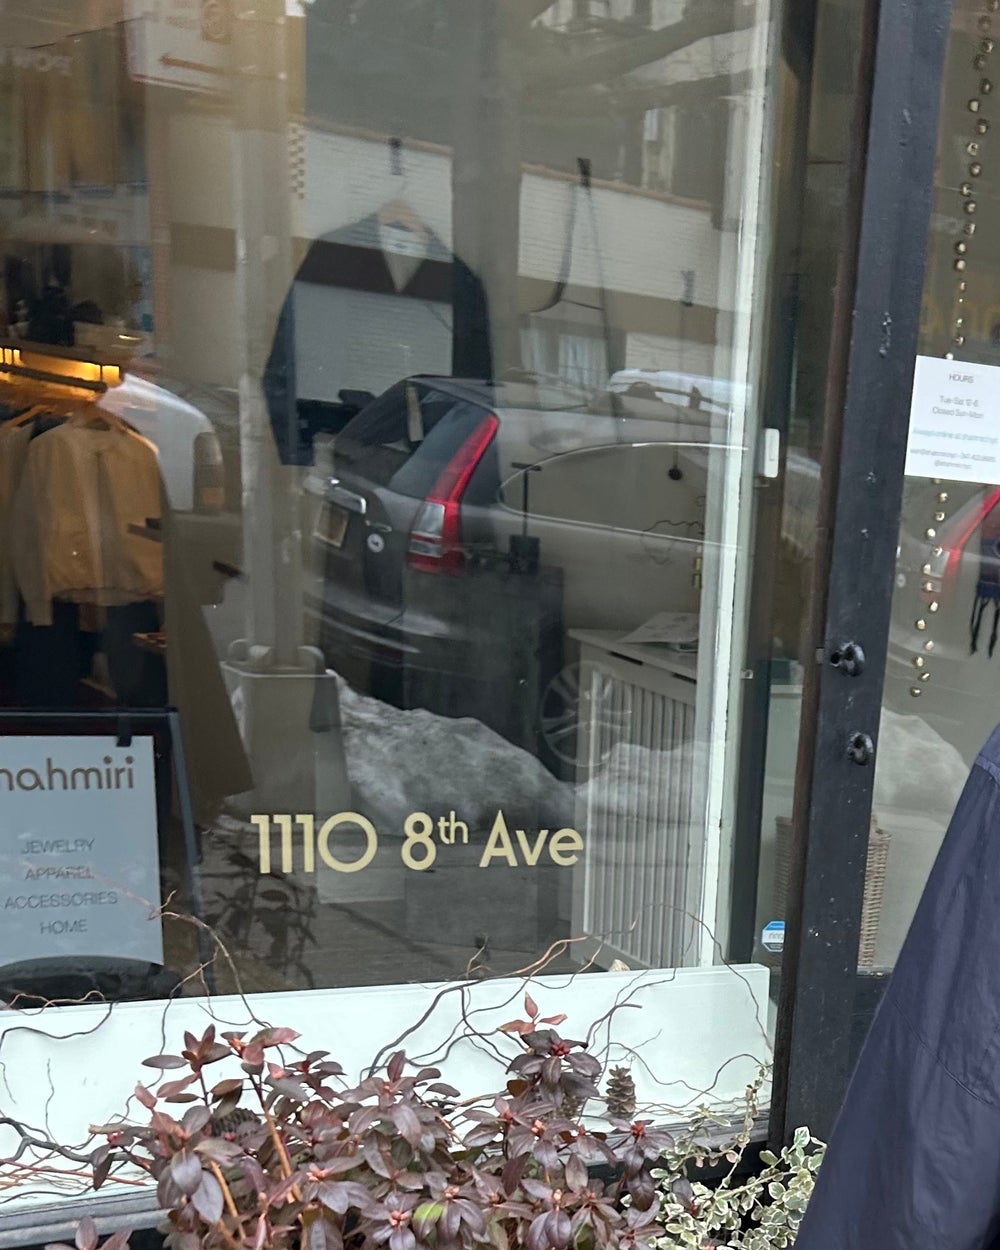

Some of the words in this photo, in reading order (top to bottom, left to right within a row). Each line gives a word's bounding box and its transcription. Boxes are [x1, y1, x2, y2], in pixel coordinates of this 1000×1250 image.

[949, 373, 974, 384] HOURS
[21, 838, 95, 855] JEWELRY
[250, 811, 378, 874] 1110
[401, 810, 469, 871] 8th
[479, 809, 584, 867] Ave
[25, 865, 95, 881] APPAREL
[4, 890, 118, 909] ACCESSORIES
[40, 918, 88, 935] HOME
